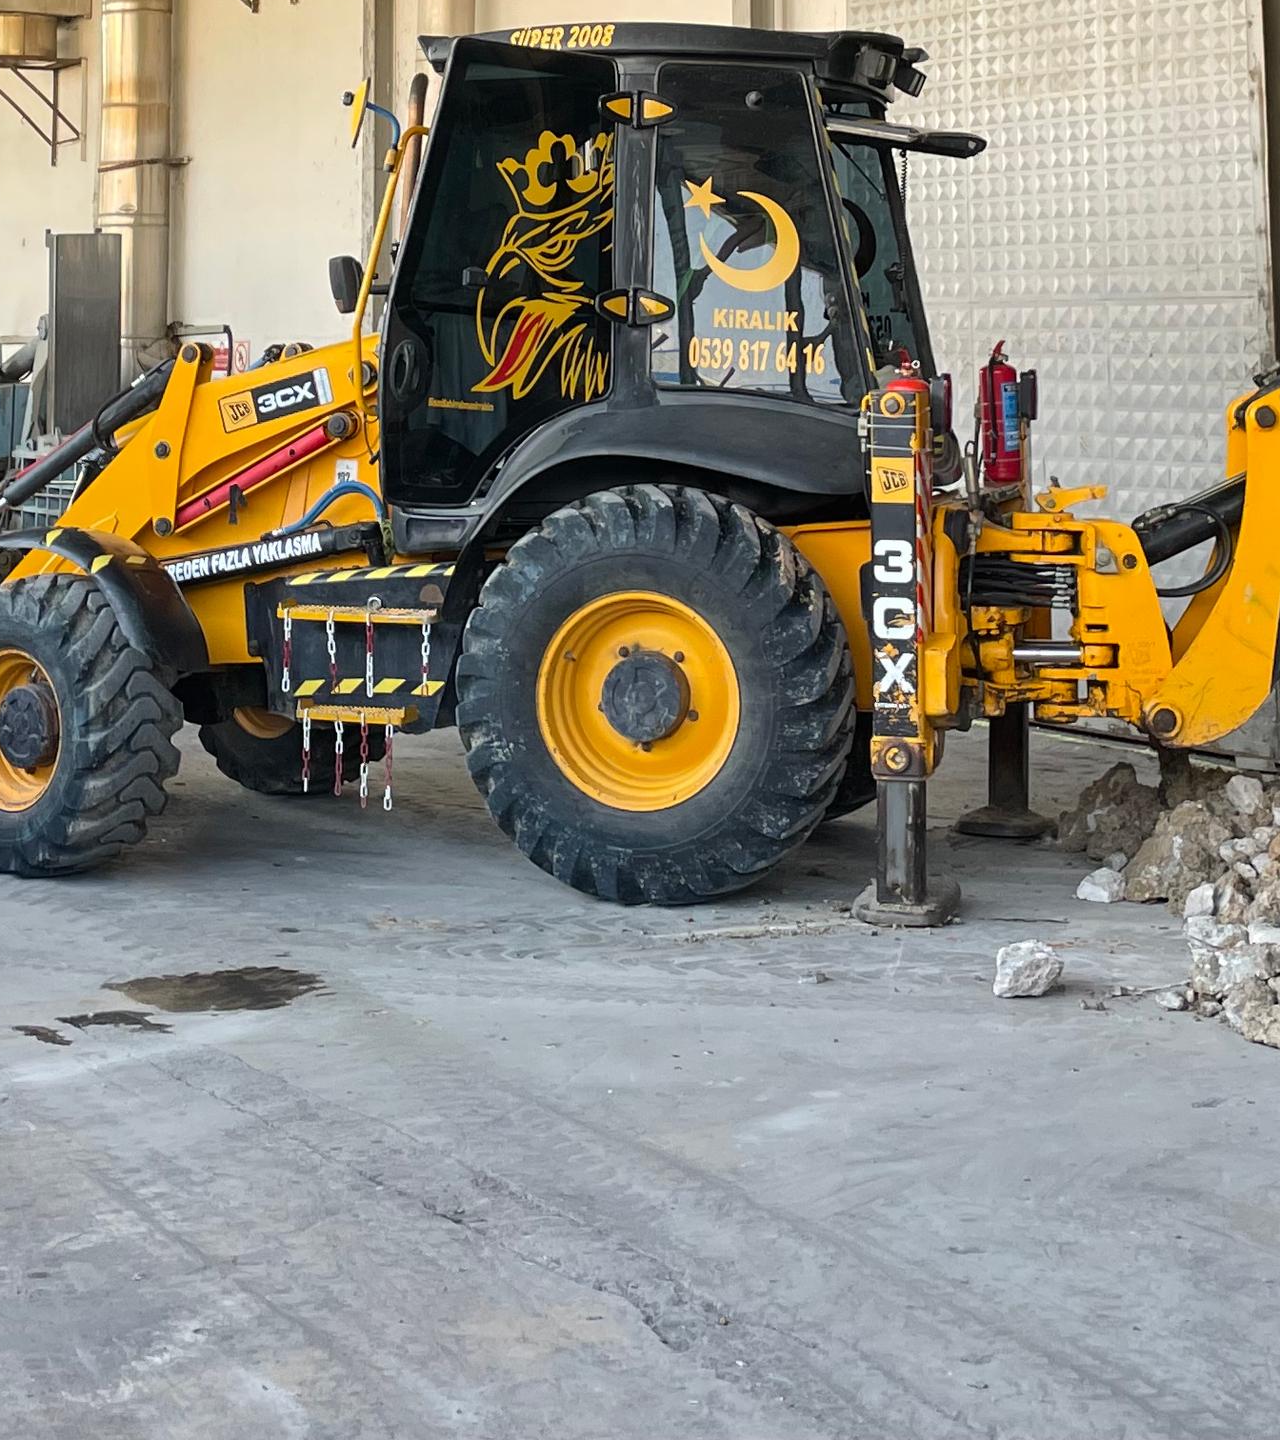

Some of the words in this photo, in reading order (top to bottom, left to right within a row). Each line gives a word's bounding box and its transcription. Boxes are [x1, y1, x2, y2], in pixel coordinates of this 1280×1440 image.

[567, 24, 615, 48] 2008
[688, 336, 733, 370] 0539
[738, 339, 771, 371] 817
[775, 341, 797, 373] 64
[803, 343, 825, 375] 16
[228, 403, 252, 421] JCB
[257, 381, 315, 413] 3CX
[883, 469, 907, 491] JCB
[211, 546, 252, 574] FAZLA
[873, 539, 915, 693] 3CX
